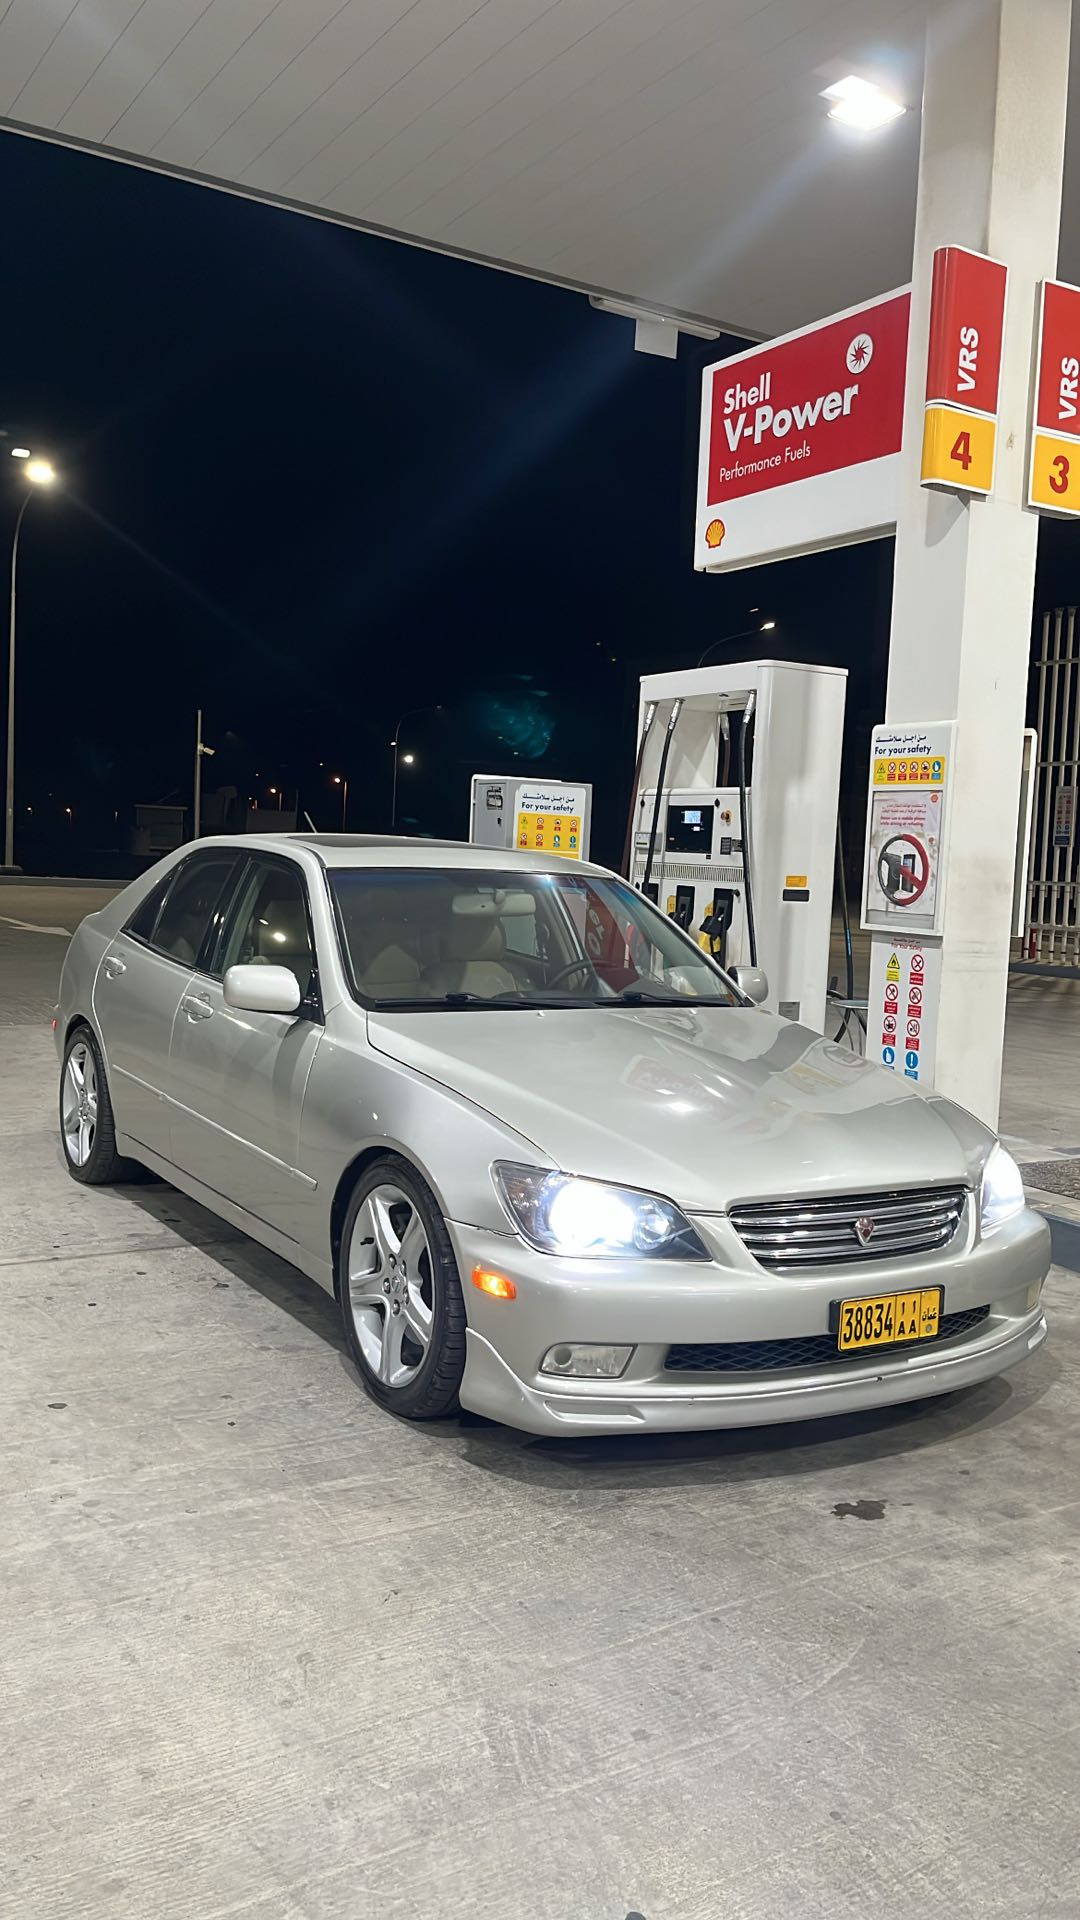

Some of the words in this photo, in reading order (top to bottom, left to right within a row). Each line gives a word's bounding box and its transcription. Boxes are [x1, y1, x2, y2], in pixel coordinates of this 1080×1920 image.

[957, 326, 980, 392] VRS
[723, 372, 771, 414] Shell
[1058, 356, 1080, 420] VRS
[723, 384, 859, 452] V-Power
[719, 454, 782, 482] Performance
[784, 440, 811, 462] Fuels
[950, 431, 972, 470] 4
[1049, 455, 1070, 494] 3
[875, 746, 887, 755] For
[889, 747, 906, 756] your
[907, 744, 932, 755] safety
[553, 804, 574, 813] safety
[843, 1302, 893, 1343] 38834
